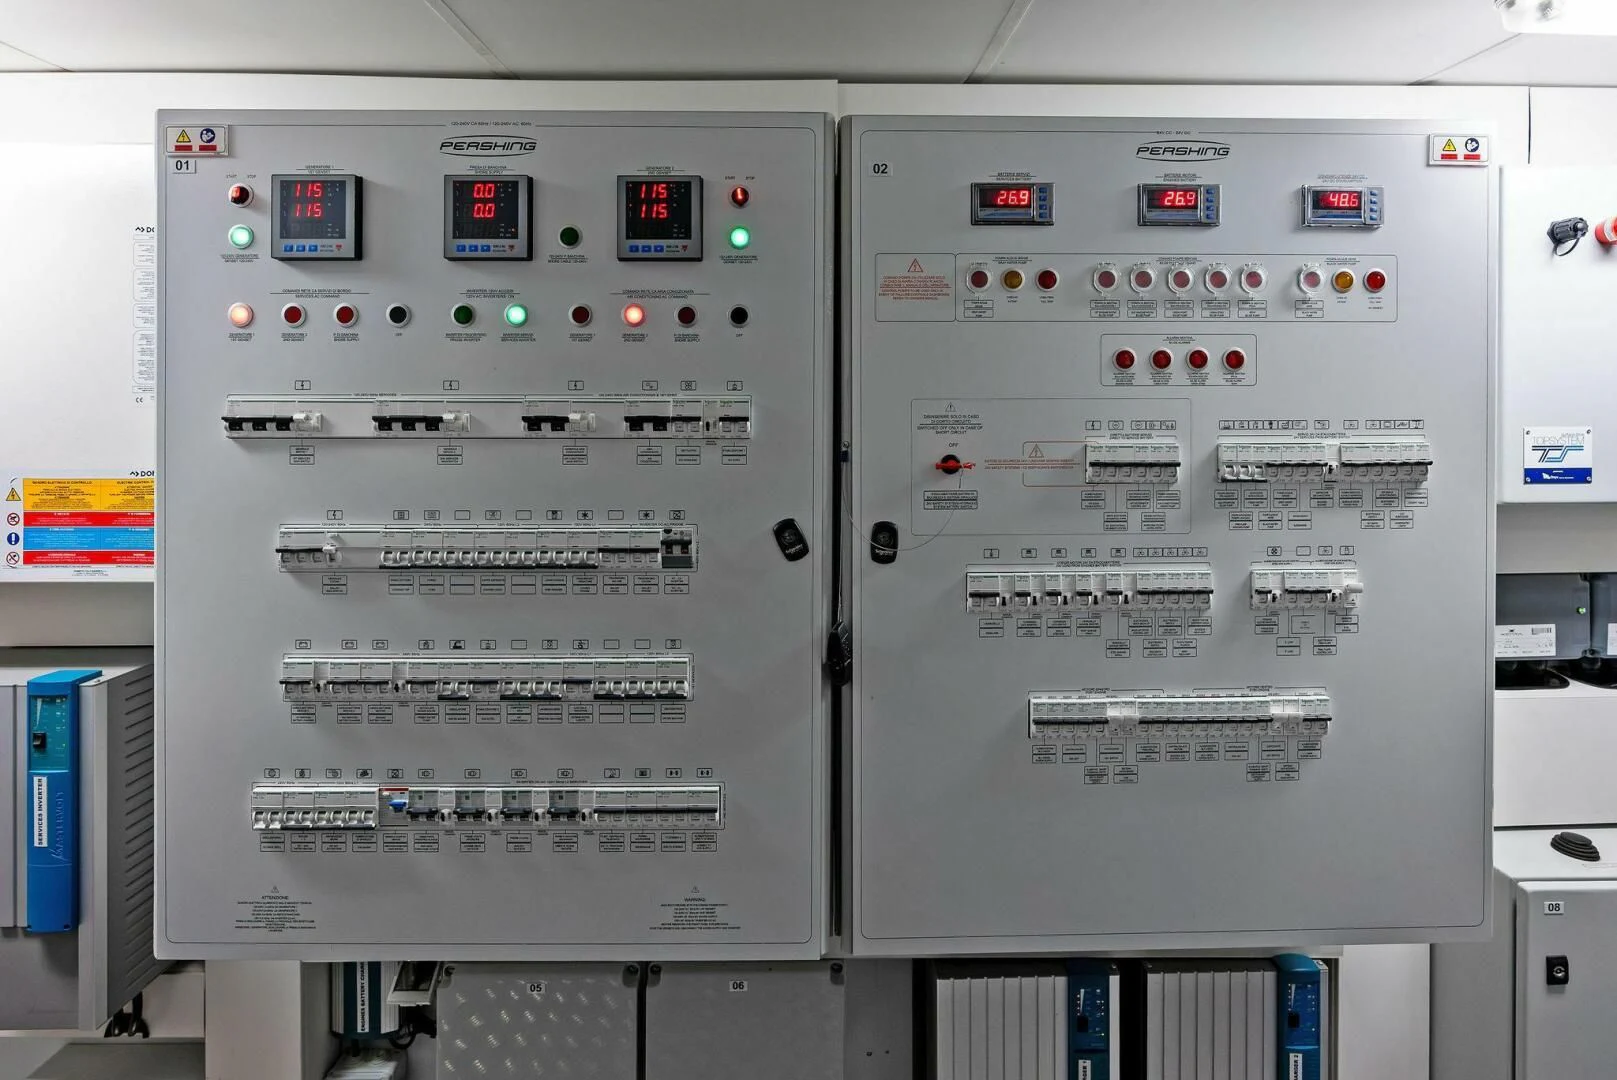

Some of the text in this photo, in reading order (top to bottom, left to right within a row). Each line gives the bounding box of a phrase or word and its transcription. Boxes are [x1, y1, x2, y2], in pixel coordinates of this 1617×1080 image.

[440, 142, 538, 150] PERSHING
[1136, 146, 1231, 156] PERSHING
[175, 160, 190, 170] 01
[873, 164, 888, 174] 02
[294, 183, 323, 198] 115
[640, 184, 668, 198] 115
[997, 190, 1028, 204] 26.9
[1164, 192, 1196, 206] 26.9
[1329, 192, 1358, 206] 48.6
[294, 203, 322, 217] 115
[640, 204, 668, 218] 115
[1548, 903, 1561, 912] 08
[530, 984, 542, 992] 05
[732, 981, 744, 990] 06
